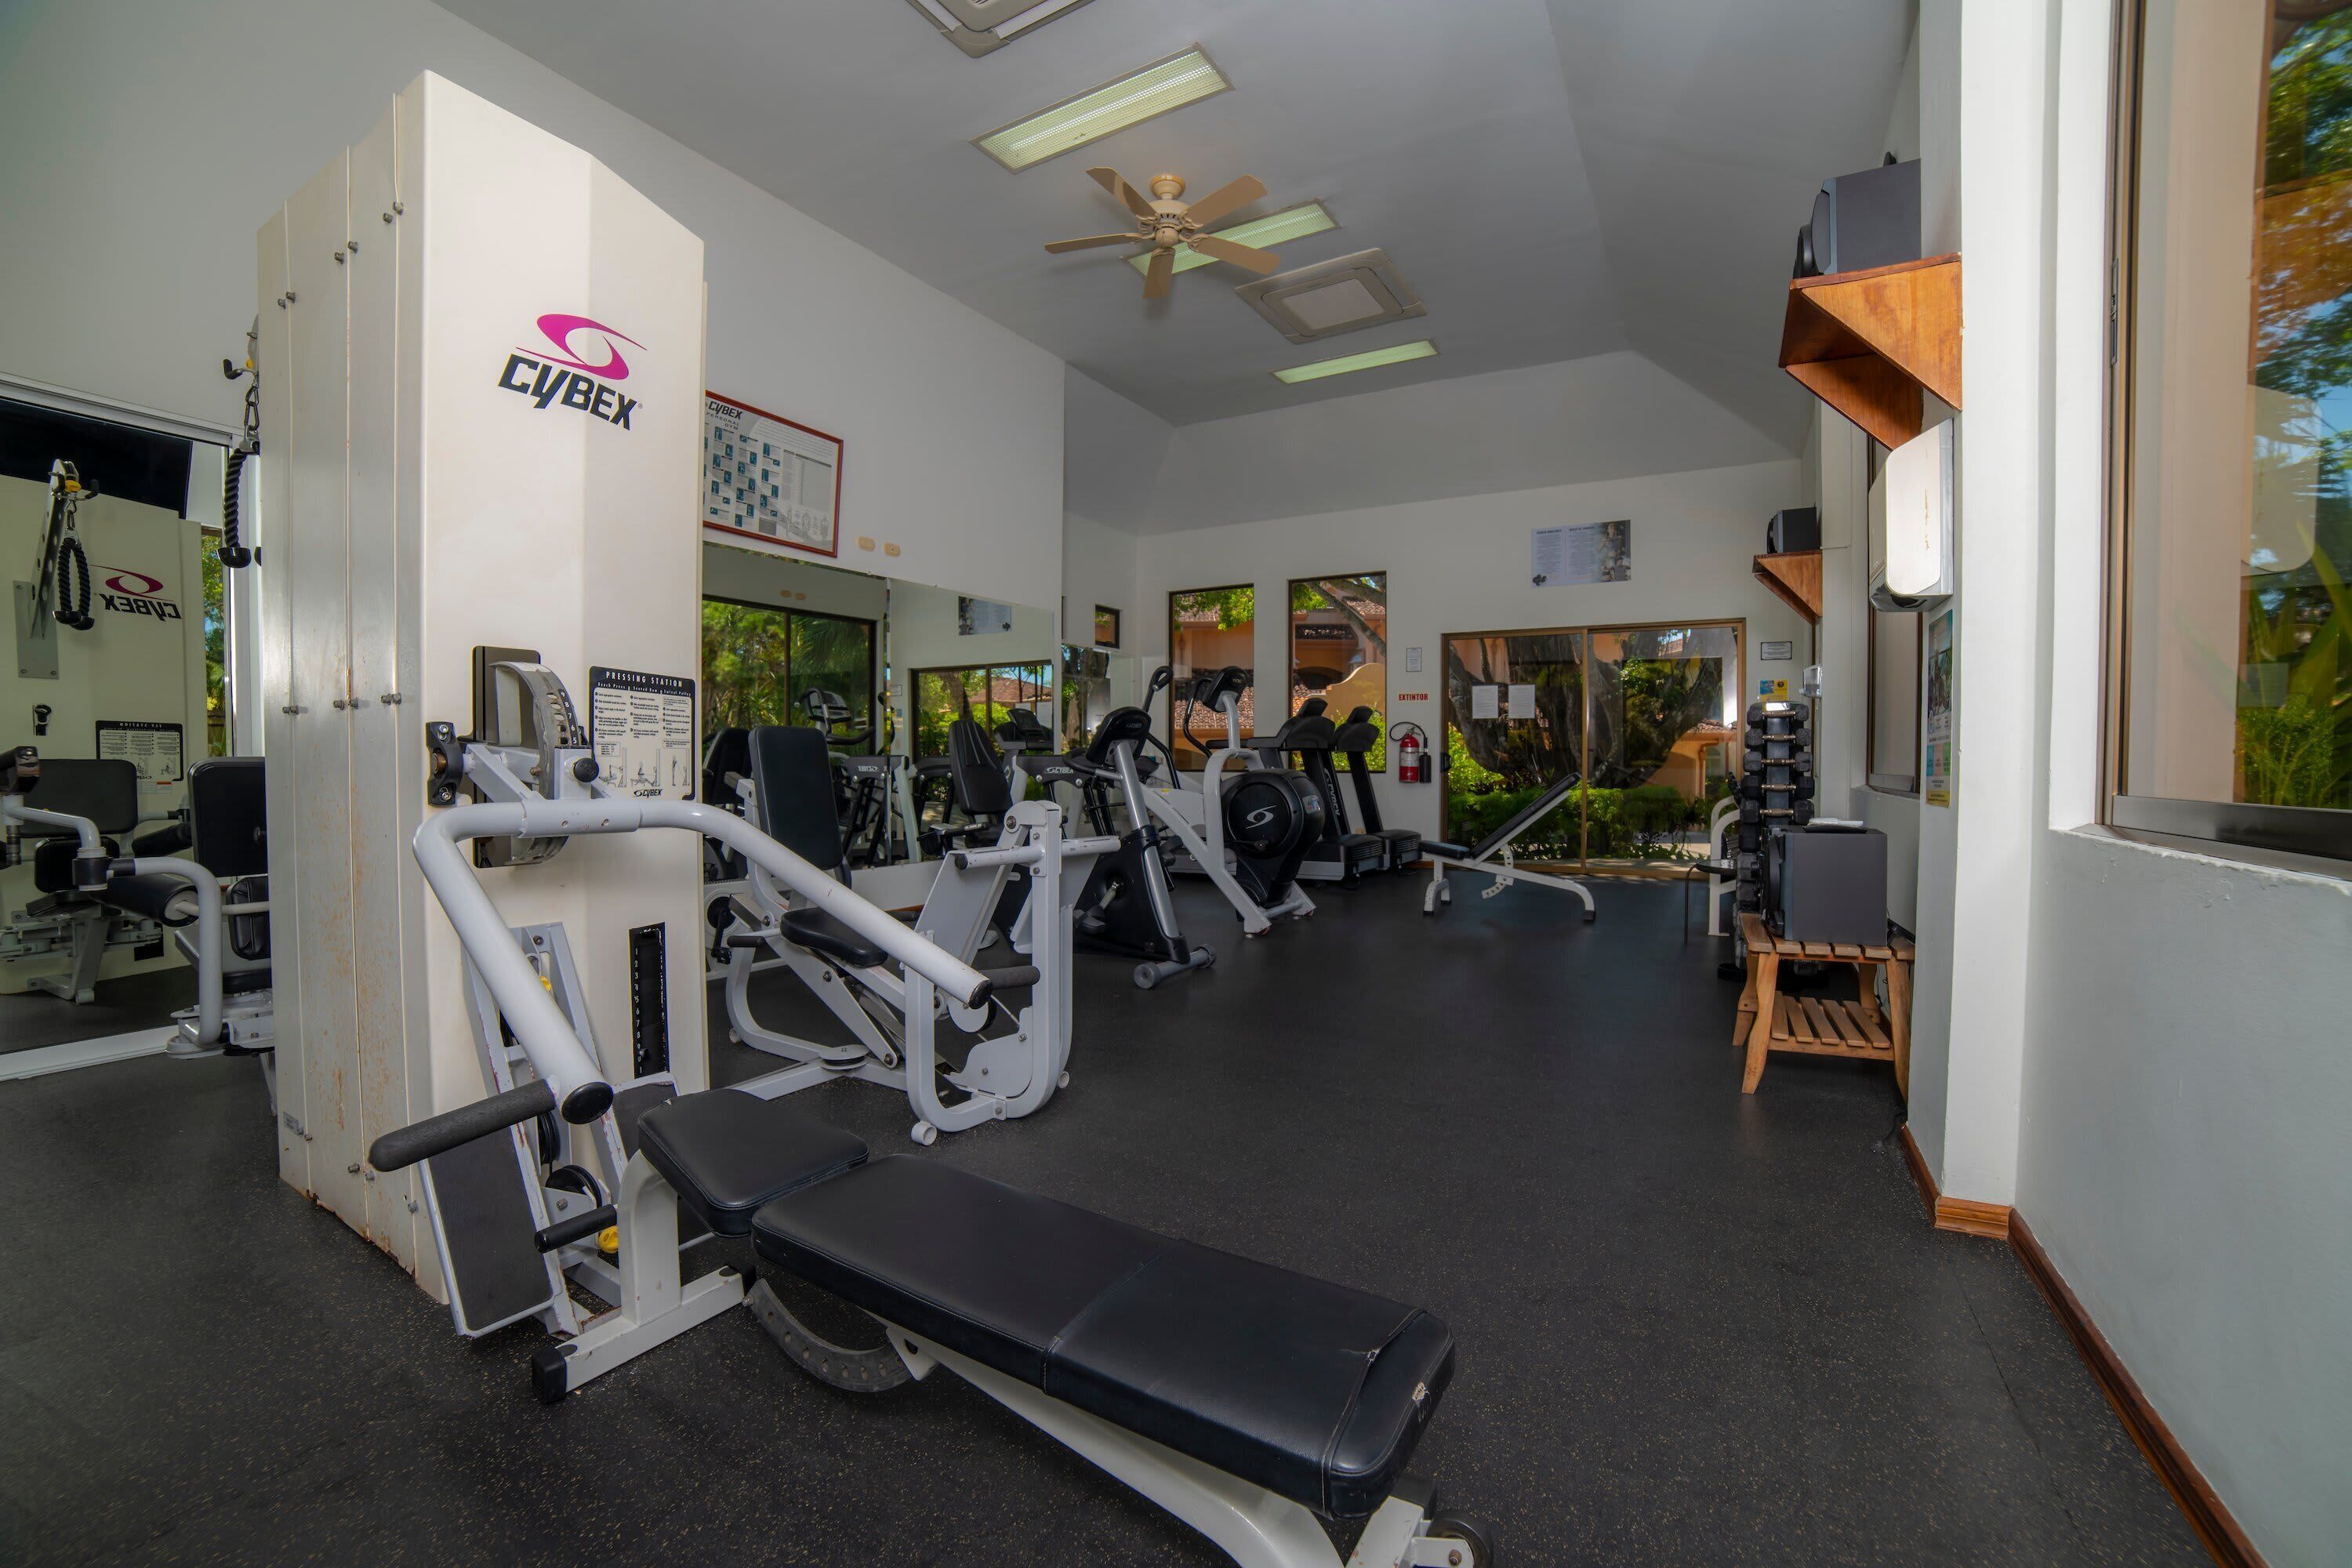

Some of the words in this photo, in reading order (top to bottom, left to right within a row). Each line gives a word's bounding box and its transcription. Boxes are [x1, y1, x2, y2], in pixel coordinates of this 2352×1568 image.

[498, 353, 637, 430] CYBEX
[706, 412, 740, 426] PERSONAL
[708, 401, 743, 420] CYBEX
[605, 671, 647, 684] PRESSING
[651, 677, 683, 688] STATION
[642, 789, 662, 798] CYBEX
